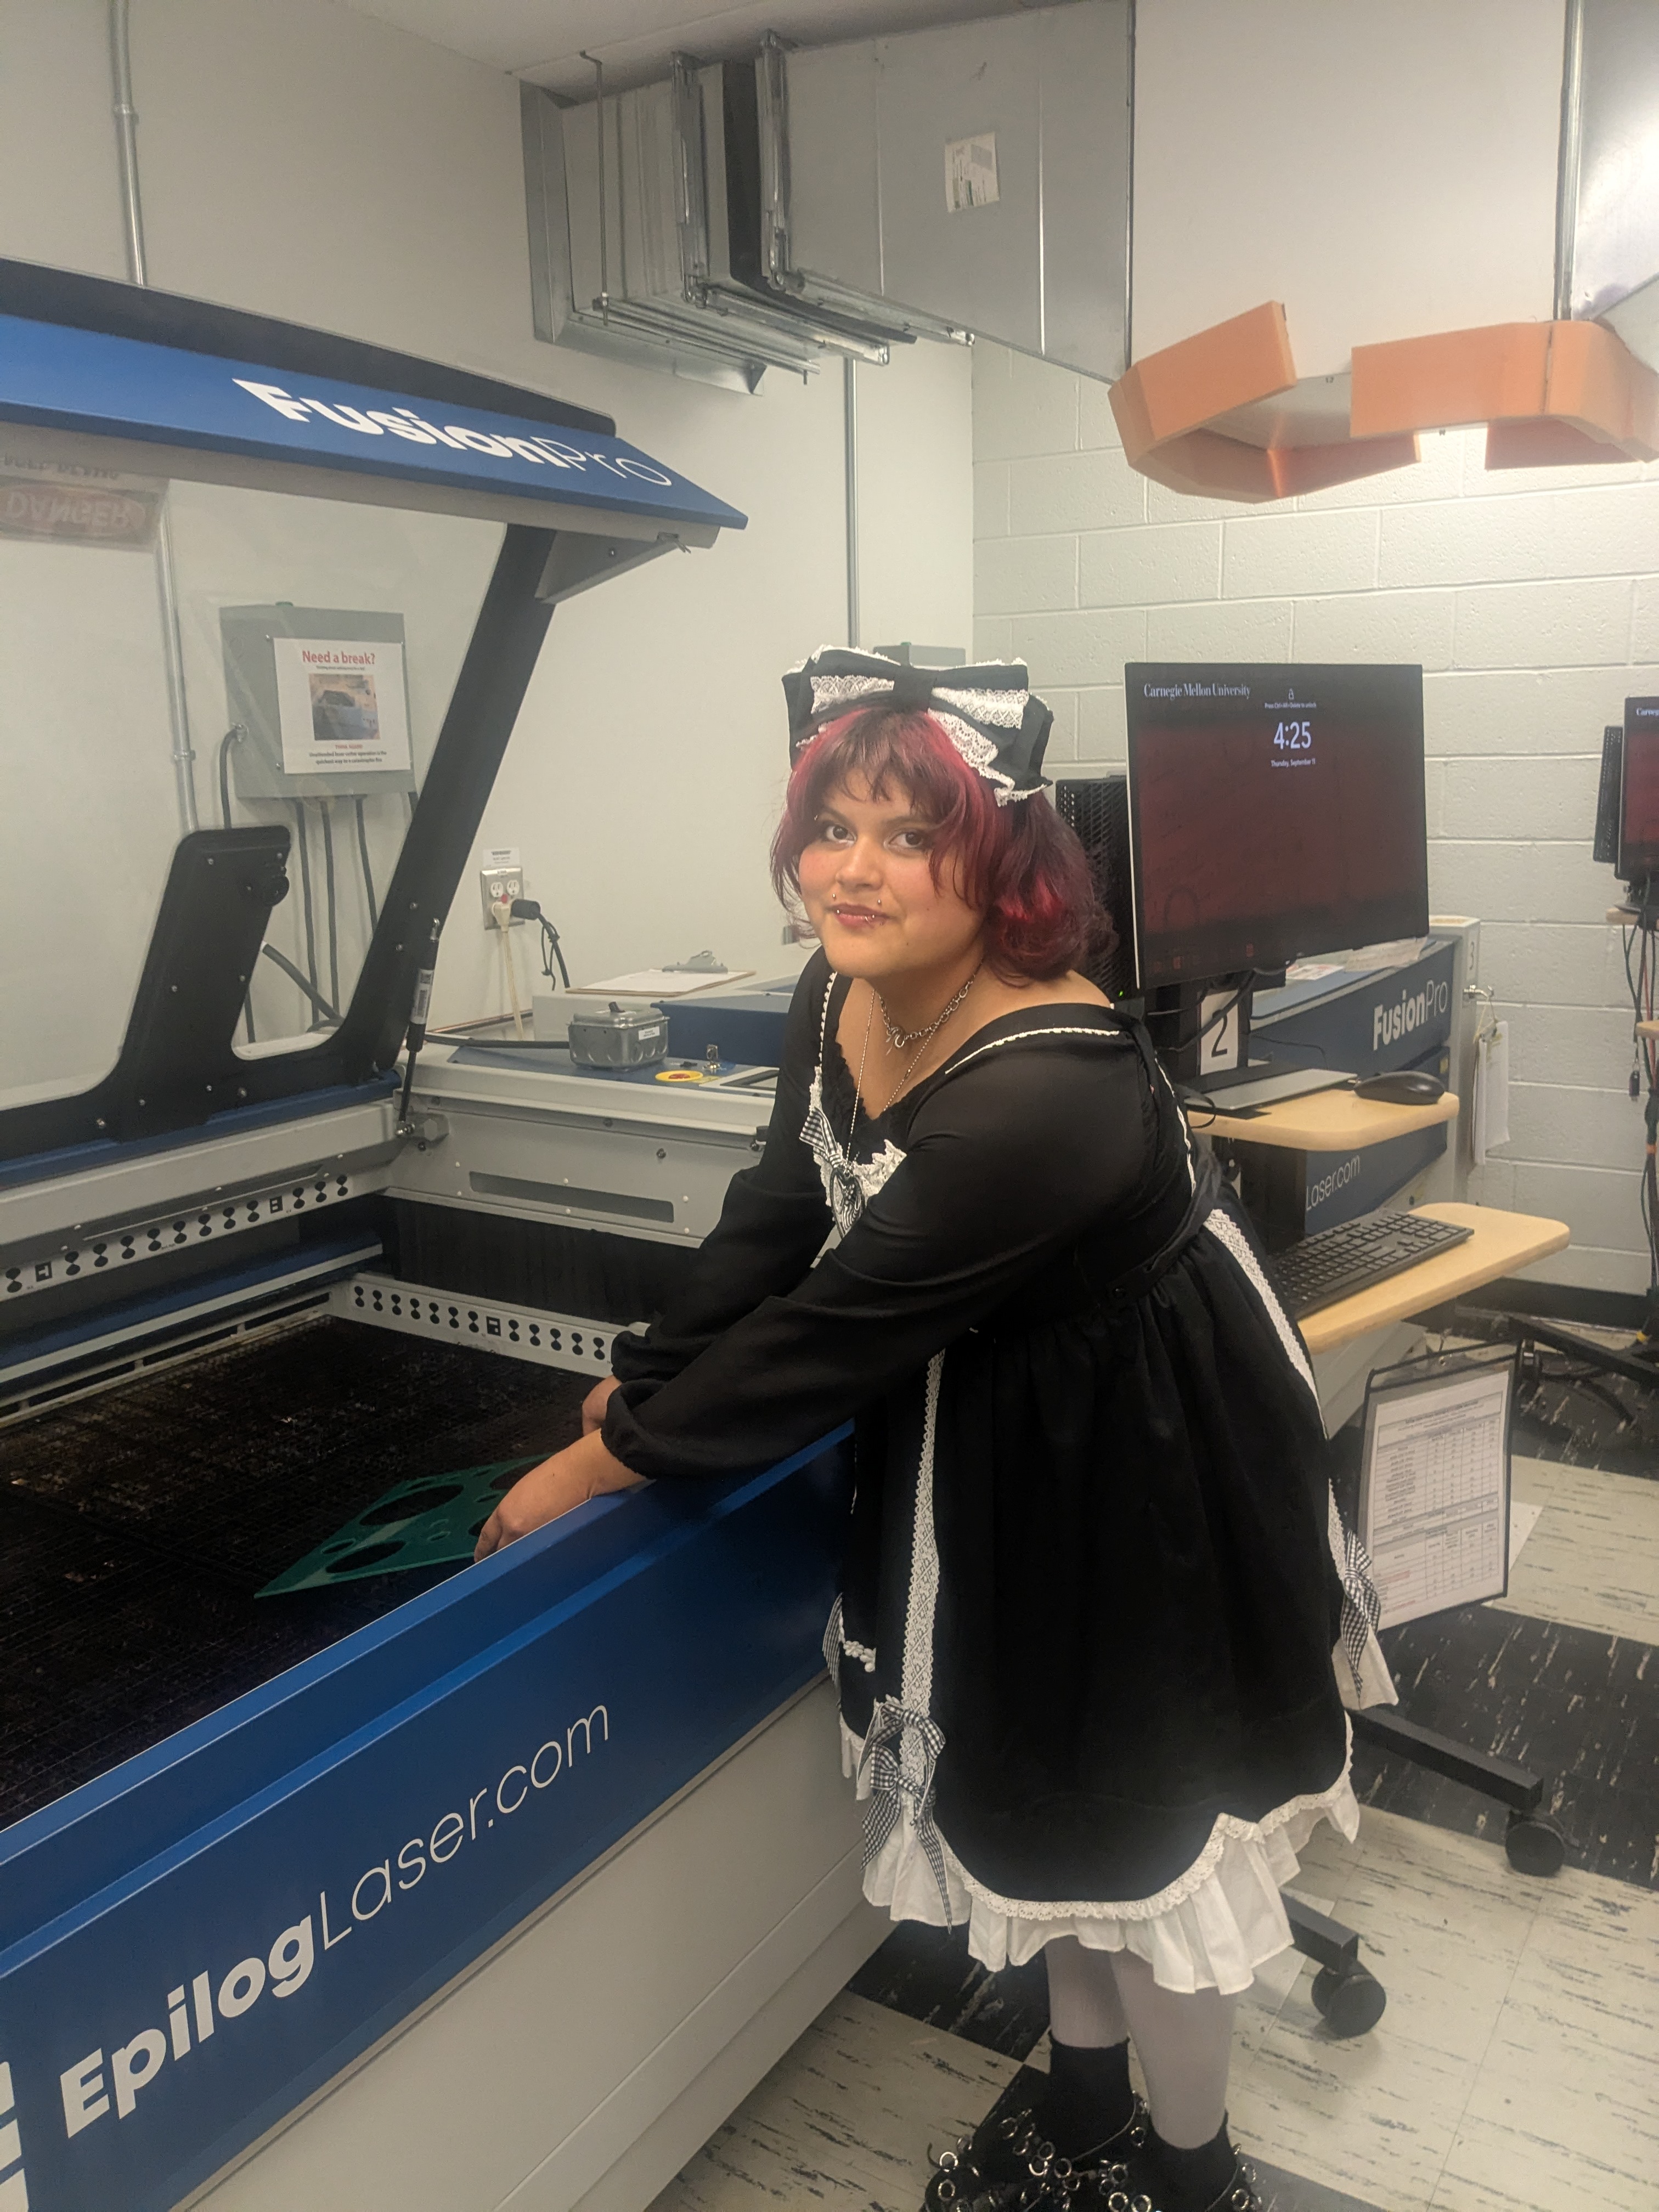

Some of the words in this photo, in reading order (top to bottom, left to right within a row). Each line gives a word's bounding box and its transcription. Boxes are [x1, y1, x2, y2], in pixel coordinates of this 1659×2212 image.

[233, 379, 673, 487] FusionPro
[302, 650, 331, 663] Need
[333, 654, 339, 663] a
[341, 651, 375, 664] break?
[1144, 683, 1182, 701] Carnegie
[1183, 683, 1211, 696] Mellon
[1212, 683, 1250, 699] University
[1274, 721, 1311, 749] 4:25
[1211, 1009, 1228, 1058] 2
[1373, 980, 1448, 1051] FusionPro
[60, 1704, 609, 2137] EpilogLaser.com
